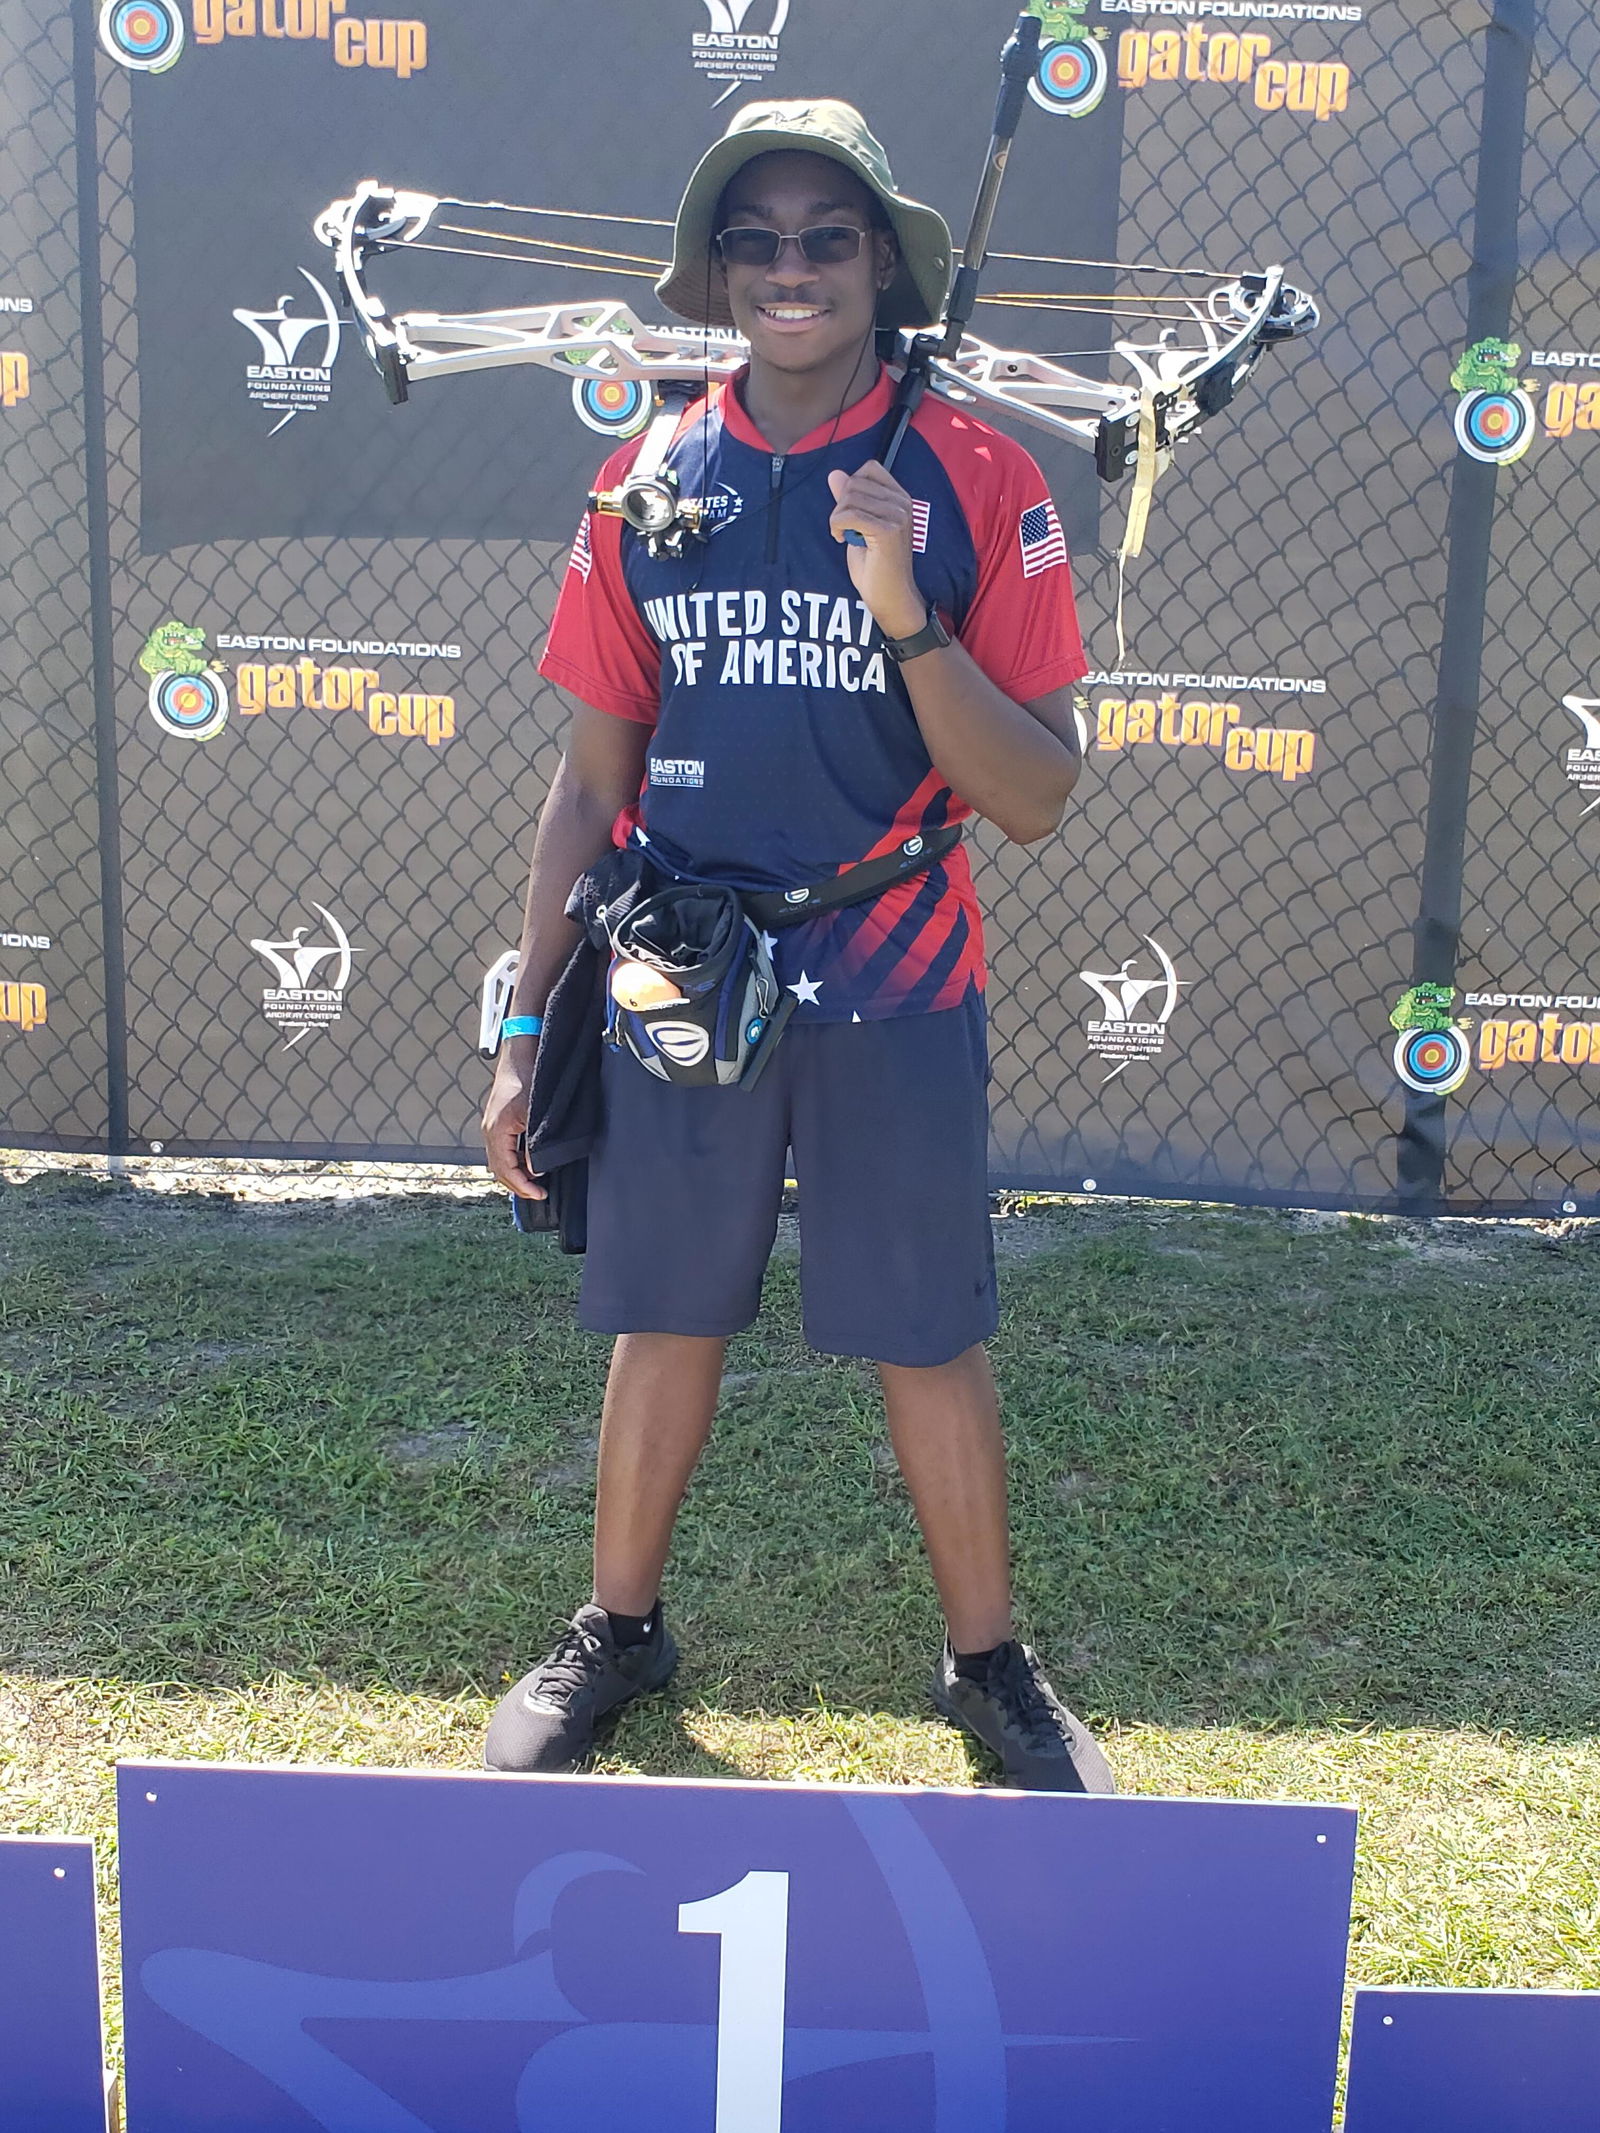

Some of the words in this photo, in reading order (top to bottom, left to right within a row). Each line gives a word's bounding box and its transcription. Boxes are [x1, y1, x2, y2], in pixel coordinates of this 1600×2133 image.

[1101, 0, 1194, 15] EASTON
[1198, 2, 1362, 22] FOUNDATIONS
[193, 0, 346, 44] gator
[334, 18, 428, 79] cup
[692, 33, 779, 49] EASTON
[692, 51, 778, 62] FOUNDATIONS
[1117, 22, 1271, 88] gator
[1254, 61, 1349, 121] cup
[247, 365, 332, 381] EASTON
[247, 382, 331, 392] FOUNDATIONS
[643, 590, 767, 642] UNITED
[217, 635, 305, 651] EASTON
[309, 638, 461, 658] FOUNDATIONS
[670, 641, 706, 687] OF
[719, 639, 886, 694] AMERICA
[1082, 671, 1169, 687] EASTON
[1173, 674, 1326, 693] FOUNDATIONS
[237, 656, 379, 715] gator
[368, 692, 456, 746] cup
[1097, 692, 1241, 751] gator
[1225, 727, 1315, 781] cup
[650, 758, 704, 776] EASTON
[263, 989, 342, 1002] EASTON
[1465, 993, 1552, 1008] EASTON
[263, 1003, 342, 1012] FOUNDATIONS
[1087, 1020, 1166, 1035] EASTON
[1087, 1035, 1164, 1045] FOUNDATIONS
[678, 1870, 789, 2133] 1
